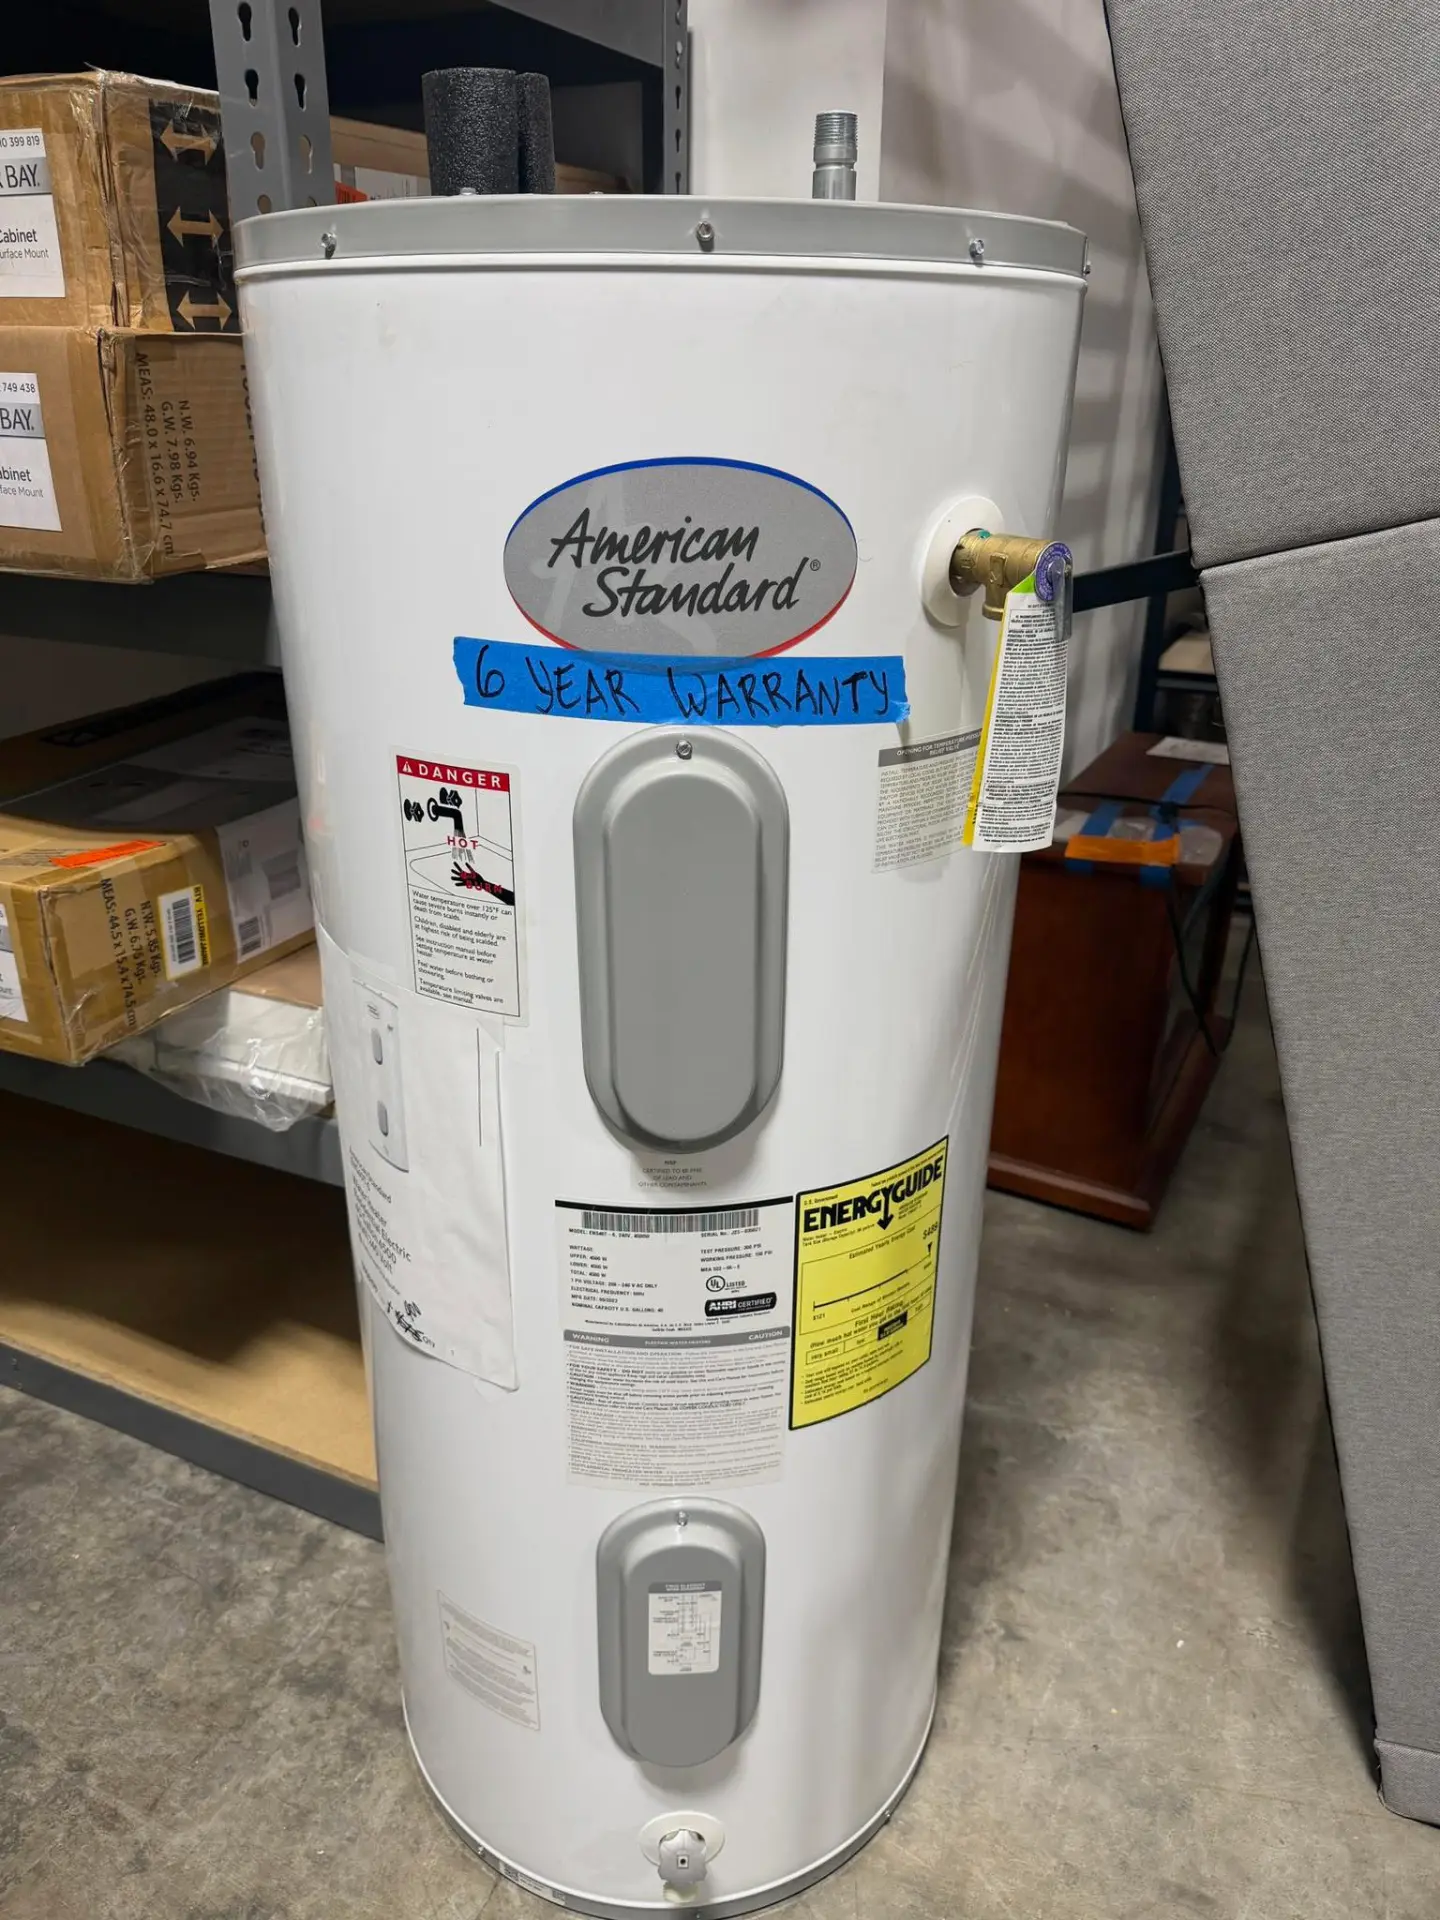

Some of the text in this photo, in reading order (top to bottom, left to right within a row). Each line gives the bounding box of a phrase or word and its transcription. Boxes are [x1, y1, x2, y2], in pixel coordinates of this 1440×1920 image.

[9, 137, 25, 147] 399
[26, 135, 40, 146] 819
[24, 248, 49, 259] Mount
[2, 383, 35, 393] 749 438
[136, 352, 174, 555] MEAS: 48.0 x 16.6 x 74.7 cm
[162, 402, 183, 503] G.W. 7.98 Kgs.
[179, 400, 201, 502] N.W. 6.94 Kgs.
[18, 487, 44, 498] Mount
[548, 508, 760, 568] American
[582, 556, 809, 617] Standard
[476, 644, 890, 720] 6 YEAR WARRANTY
[418, 764, 501, 788] DANGER
[447, 836, 479, 850] HOT
[100, 878, 117, 914] MEAS:
[110, 916, 123, 940] 44.5
[412, 890, 429, 899] Water
[430, 896, 465, 908] temperature
[466, 903, 480, 911] over
[428, 902, 446, 911] severe
[465, 911, 489, 921] instantly
[428, 909, 442, 917] from
[462, 926, 473, 935] and
[474, 931, 494, 940] elderly
[477, 950, 496, 958] before
[804, 1155, 944, 1233] ENERGYGUIDE
[709, 1300, 737, 1311] AHRI
[572, 1330, 783, 1343] WARNING CAUTION
